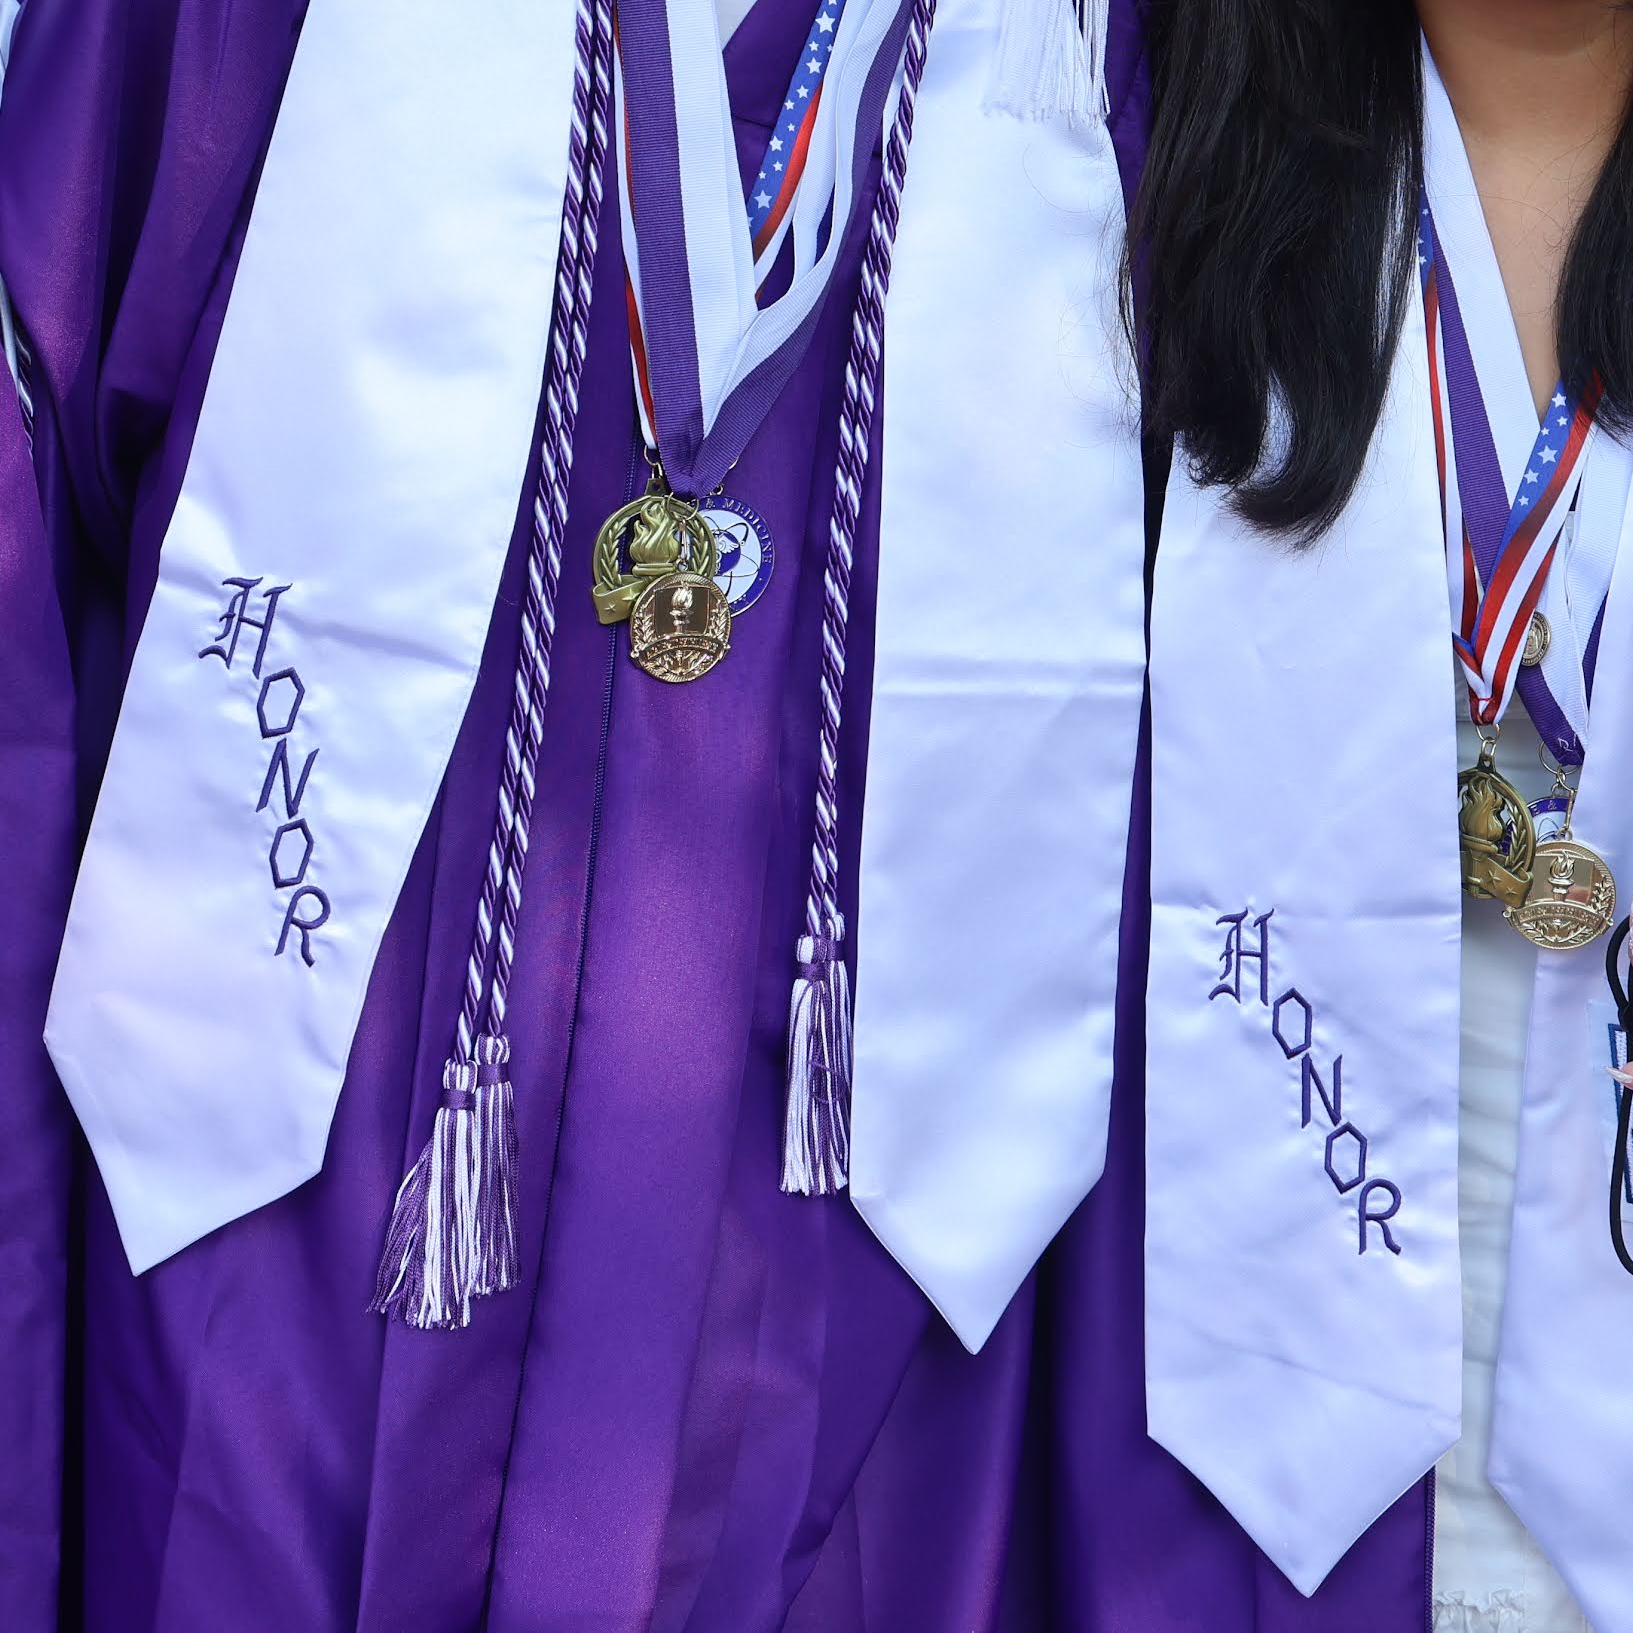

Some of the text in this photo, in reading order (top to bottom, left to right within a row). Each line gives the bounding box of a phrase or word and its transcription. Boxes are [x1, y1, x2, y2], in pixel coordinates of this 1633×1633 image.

[722, 497, 773, 564] MEDICINE
[199, 576, 331, 968] HONOR
[1208, 907, 1402, 1256] HONOR
